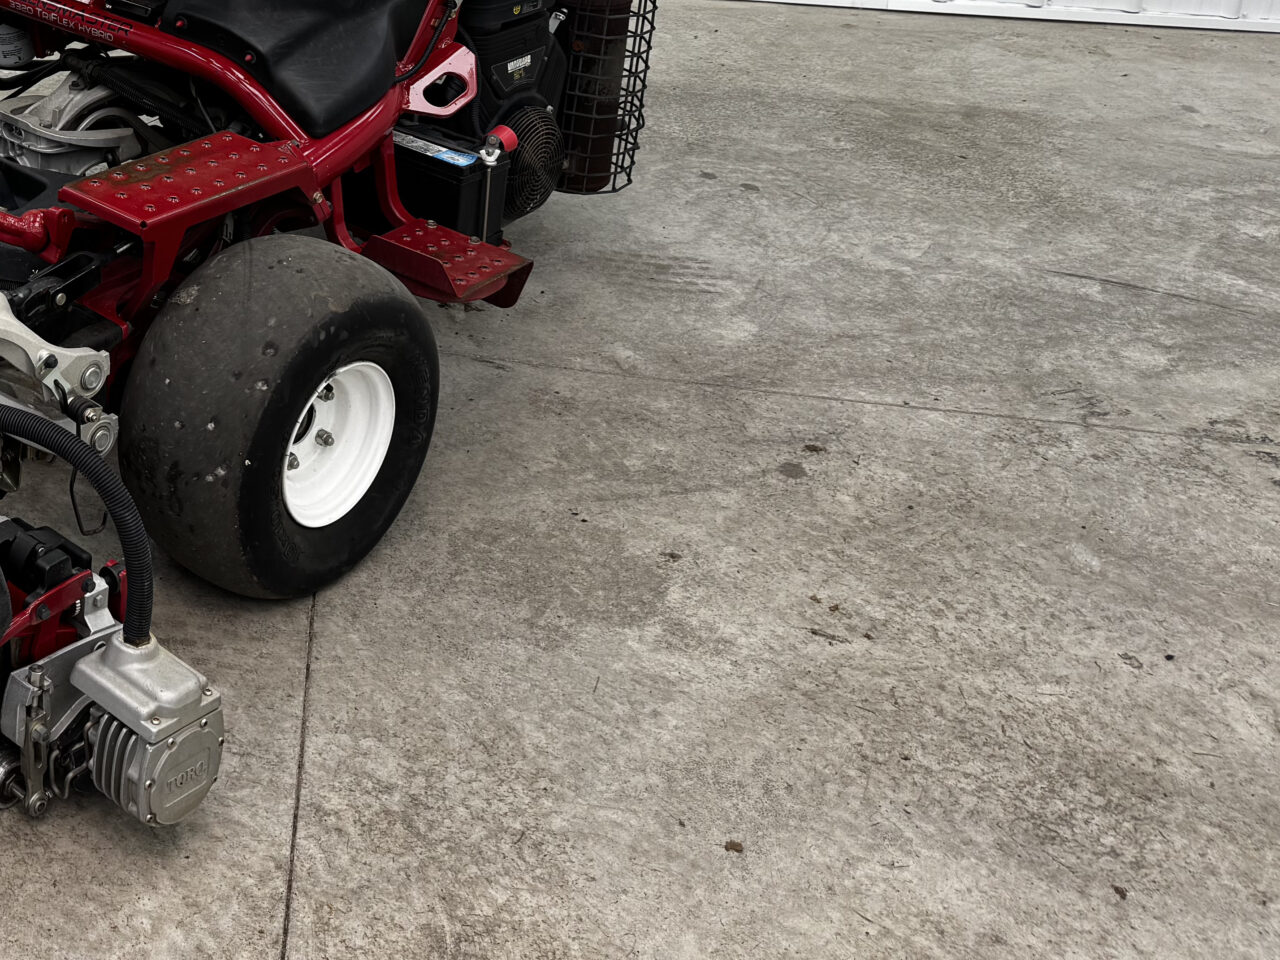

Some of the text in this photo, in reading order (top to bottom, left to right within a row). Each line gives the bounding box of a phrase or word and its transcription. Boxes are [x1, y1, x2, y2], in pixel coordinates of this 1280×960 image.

[9, 0, 34, 15] 3320
[78, 22, 114, 42] HYBRID
[166, 760, 205, 792] TORO
